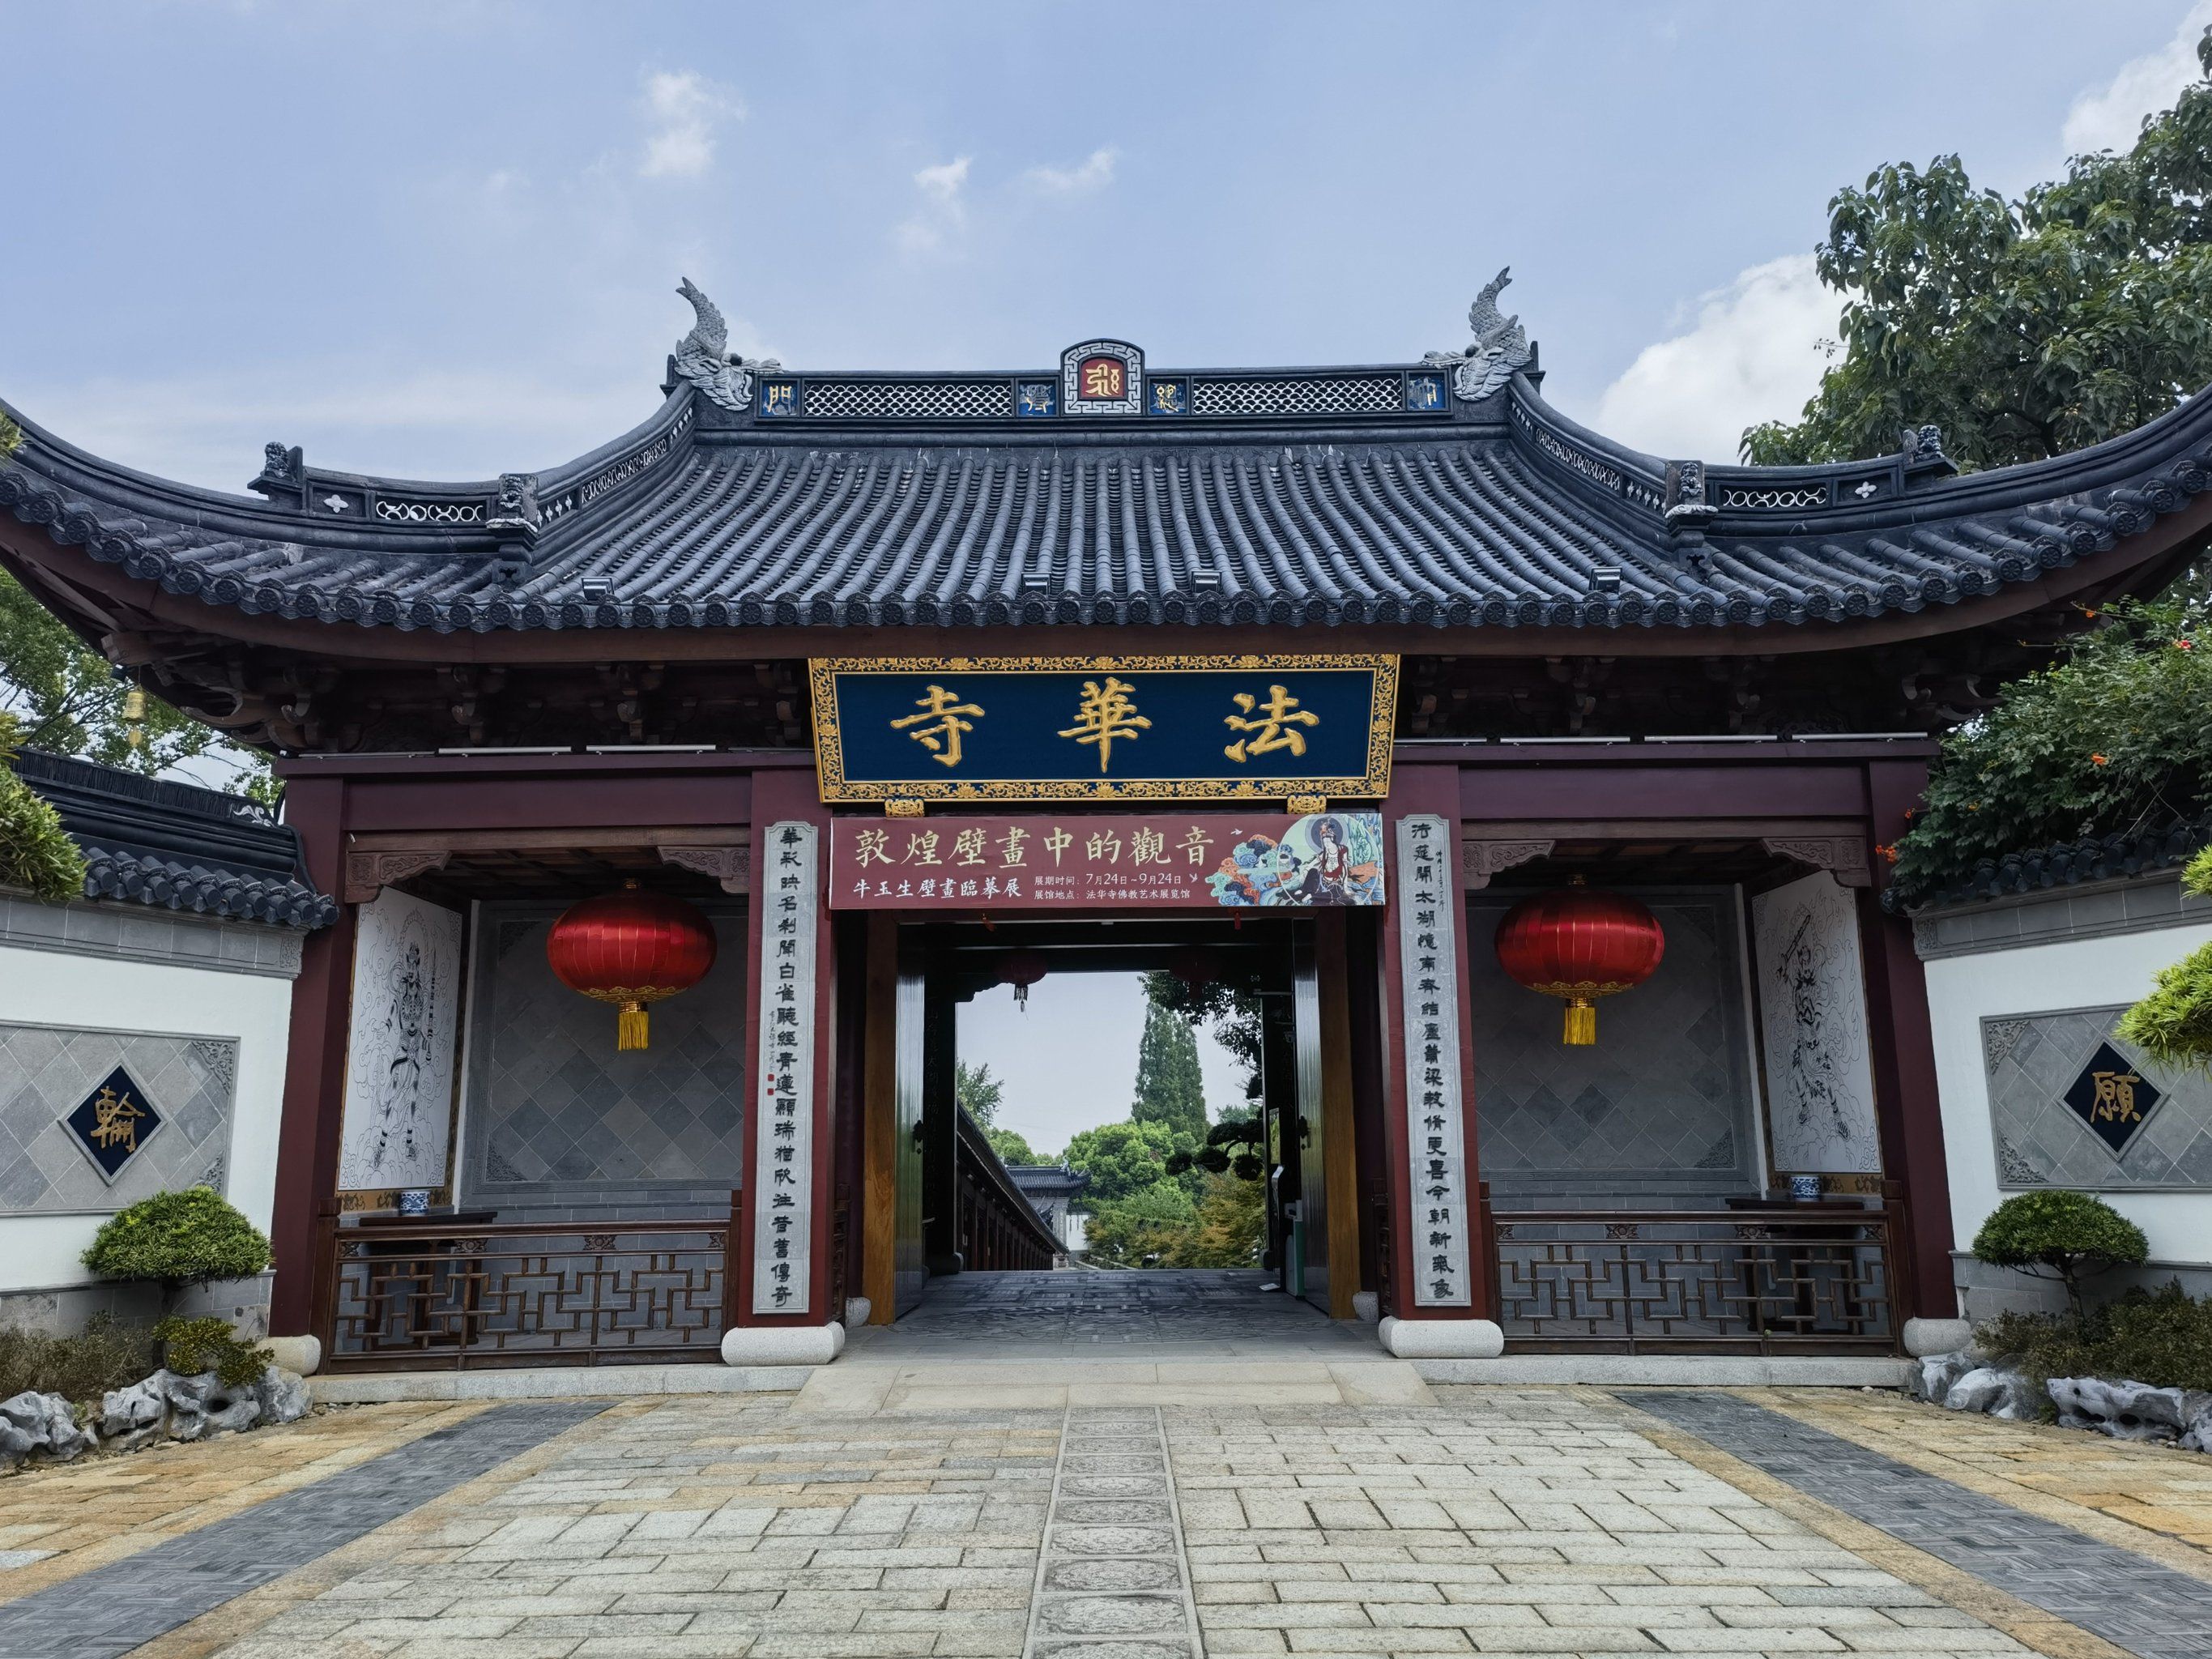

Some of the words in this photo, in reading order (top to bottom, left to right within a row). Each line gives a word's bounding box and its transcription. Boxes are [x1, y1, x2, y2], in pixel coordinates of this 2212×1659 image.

[890, 677, 1319, 774] 法華寺
[855, 825, 1214, 868] 敦煌壁畫中的觀音
[853, 876, 1023, 900] 牛玉生壁畫臨摹展
[91, 1085, 146, 1153] 輪
